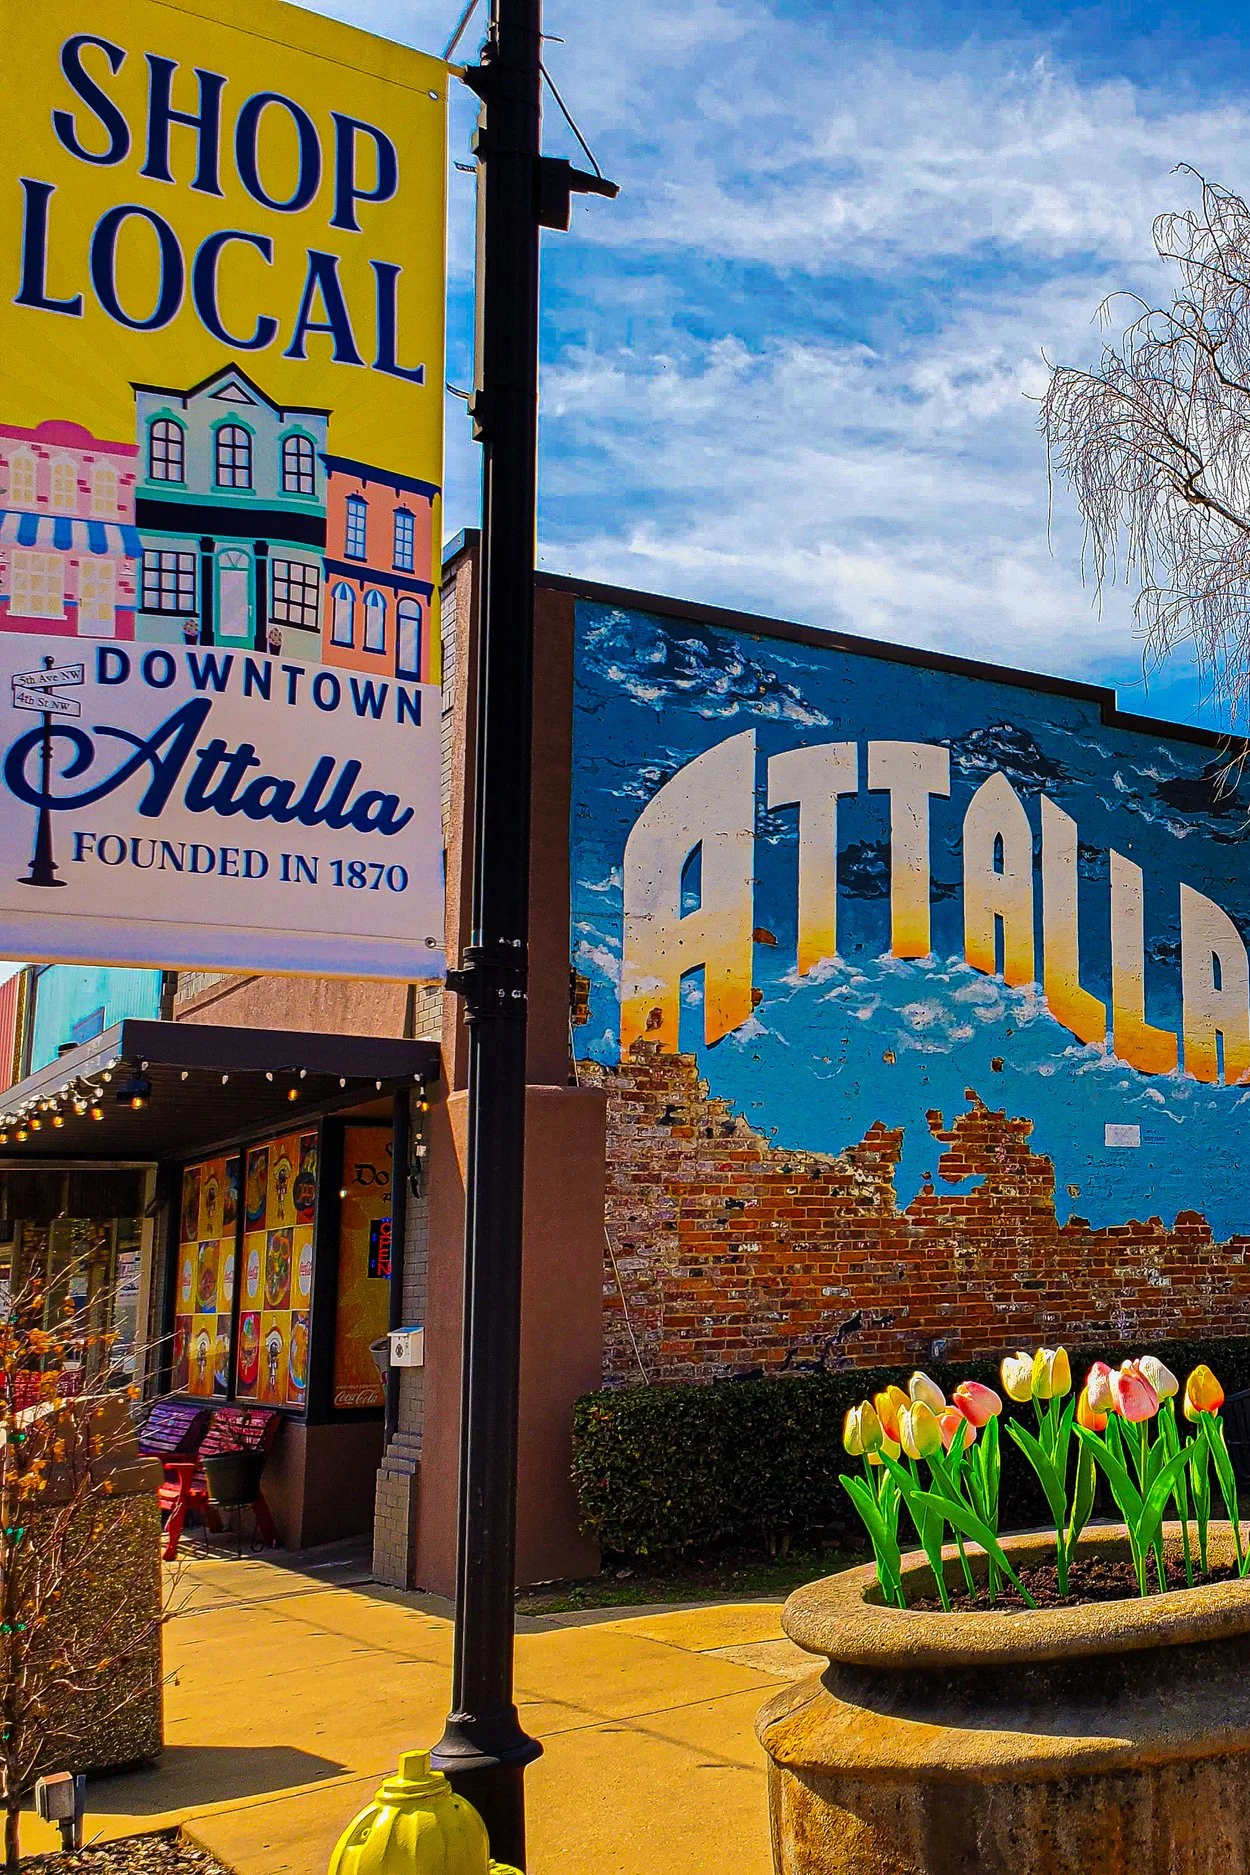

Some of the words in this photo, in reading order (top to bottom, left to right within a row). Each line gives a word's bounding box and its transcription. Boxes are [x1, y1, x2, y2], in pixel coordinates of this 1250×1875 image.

[53, 33, 398, 232] SHOP
[14, 177, 425, 385] LOCAL
[17, 692, 35, 705] 4th
[37, 697, 48, 707] St
[51, 701, 70, 710] NW
[19, 675, 36, 685] 5th
[40, 675, 59, 683] Ave
[60, 670, 81, 680] NW
[96, 646, 422, 727] DOWNTOWN
[4, 698, 415, 836] Attalla
[71, 831, 269, 879] FOUNDED
[279, 853, 319, 886] IN
[329, 859, 410, 892] 1870
